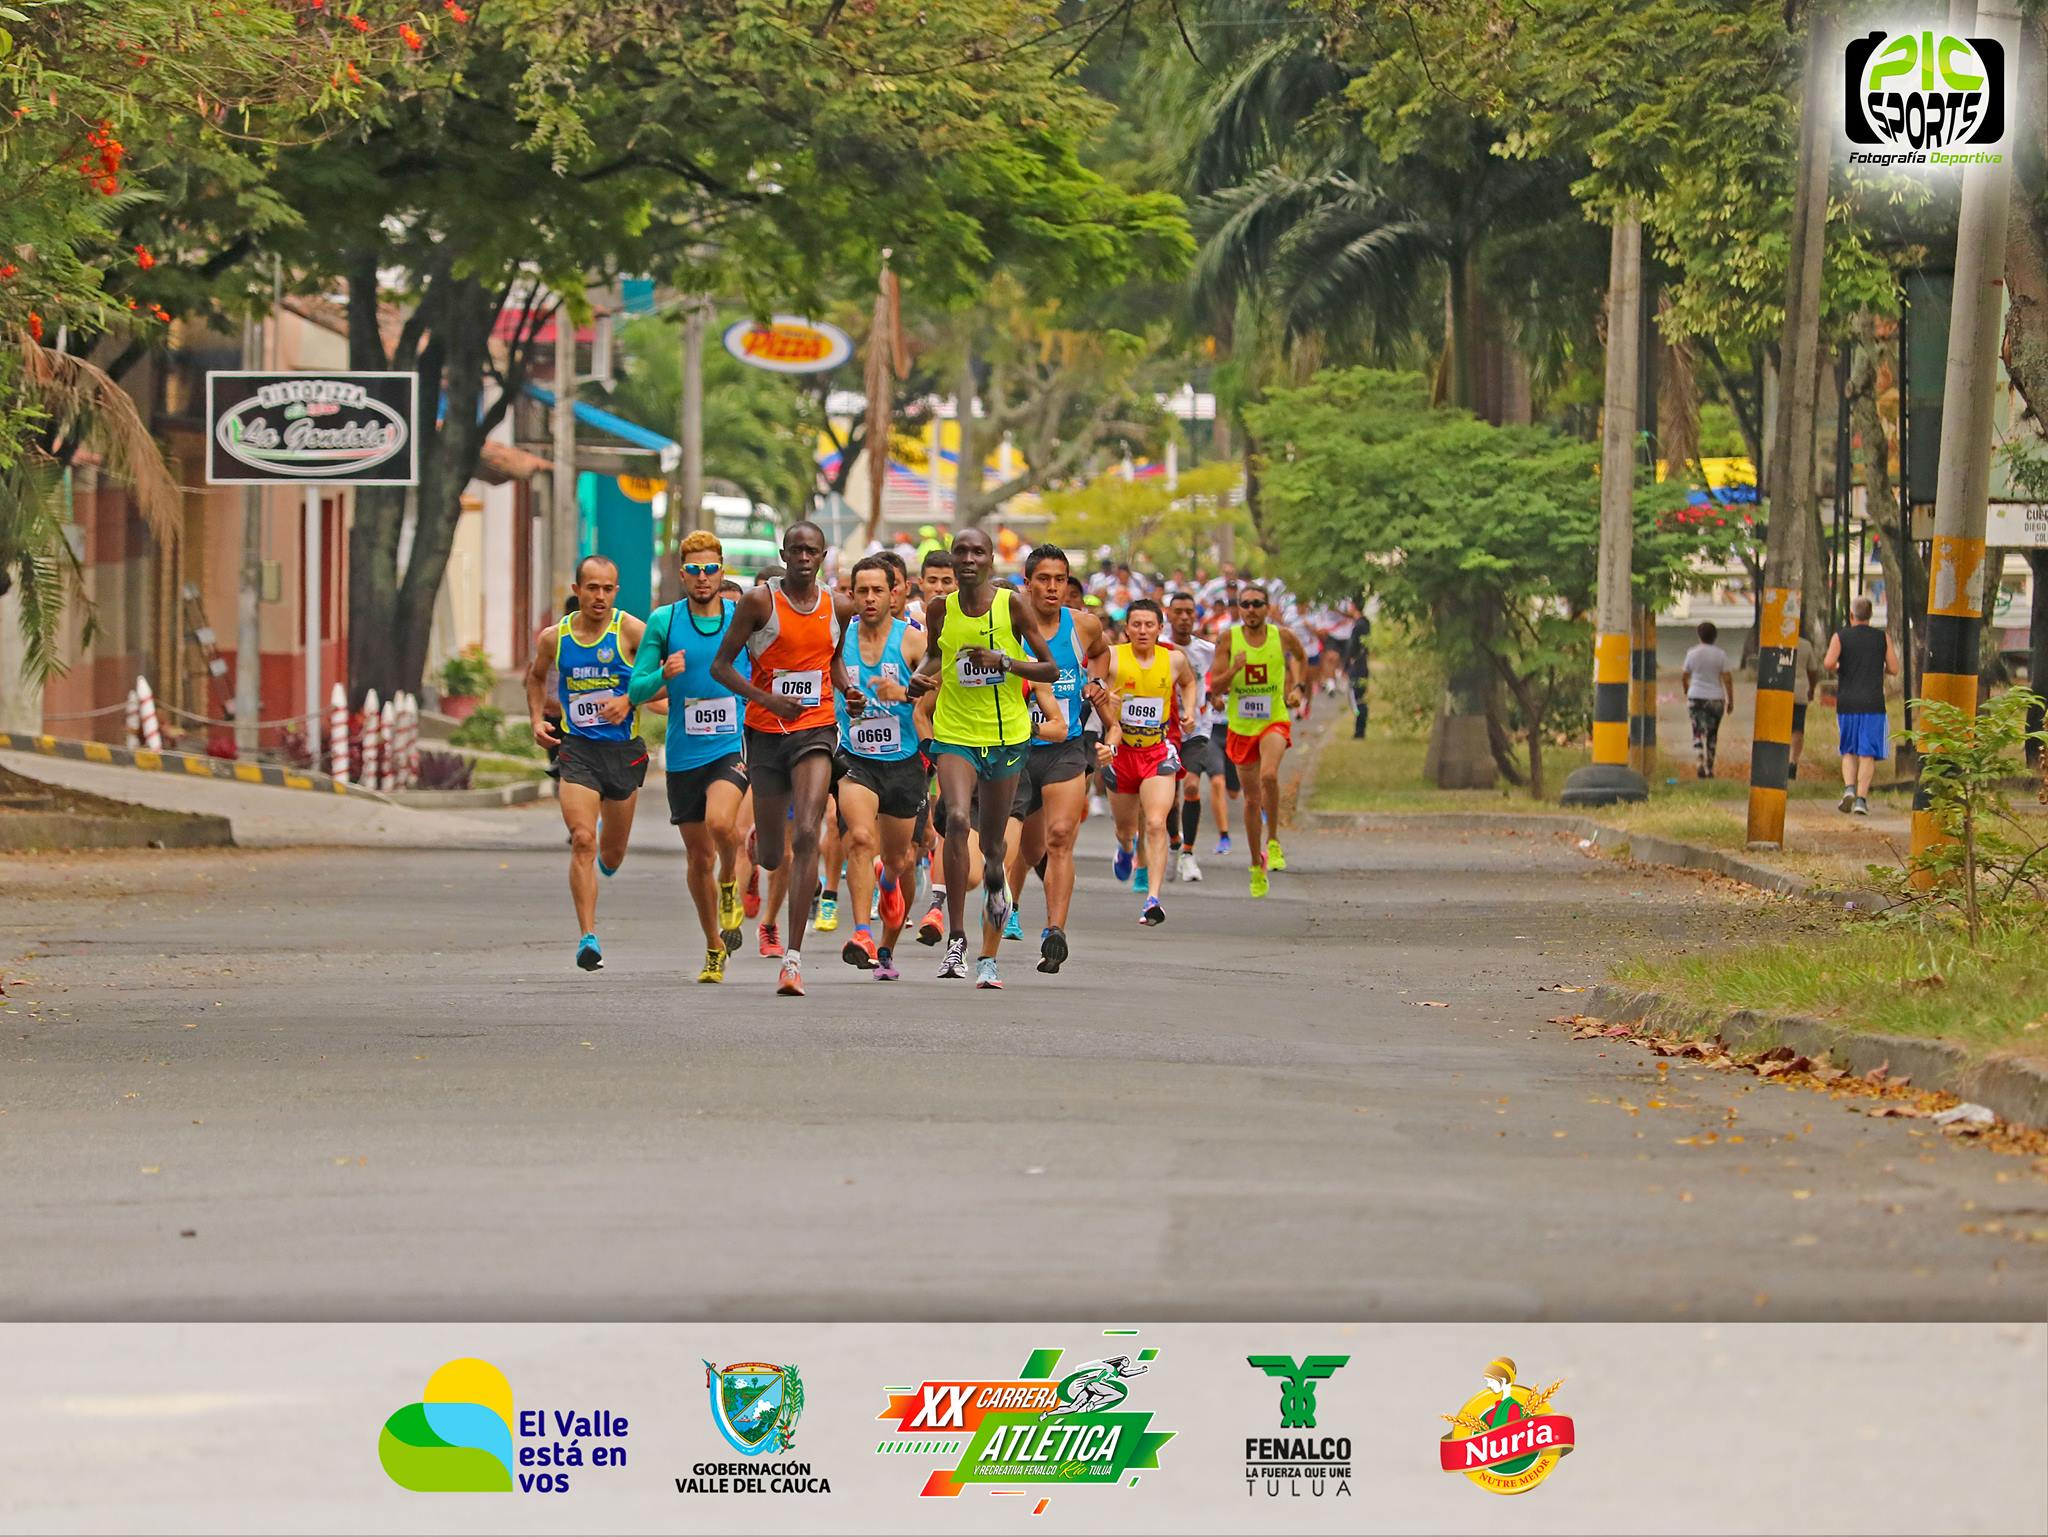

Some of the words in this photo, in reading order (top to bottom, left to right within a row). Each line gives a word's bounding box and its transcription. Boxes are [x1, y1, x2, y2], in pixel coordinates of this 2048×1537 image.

[572, 667, 610, 679] BIKILA
[782, 681, 812, 695] 0768
[578, 702, 605, 717] 081
[695, 709, 726, 723] 0519
[1128, 704, 1156, 718] 0698
[857, 728, 892, 744] 0669
